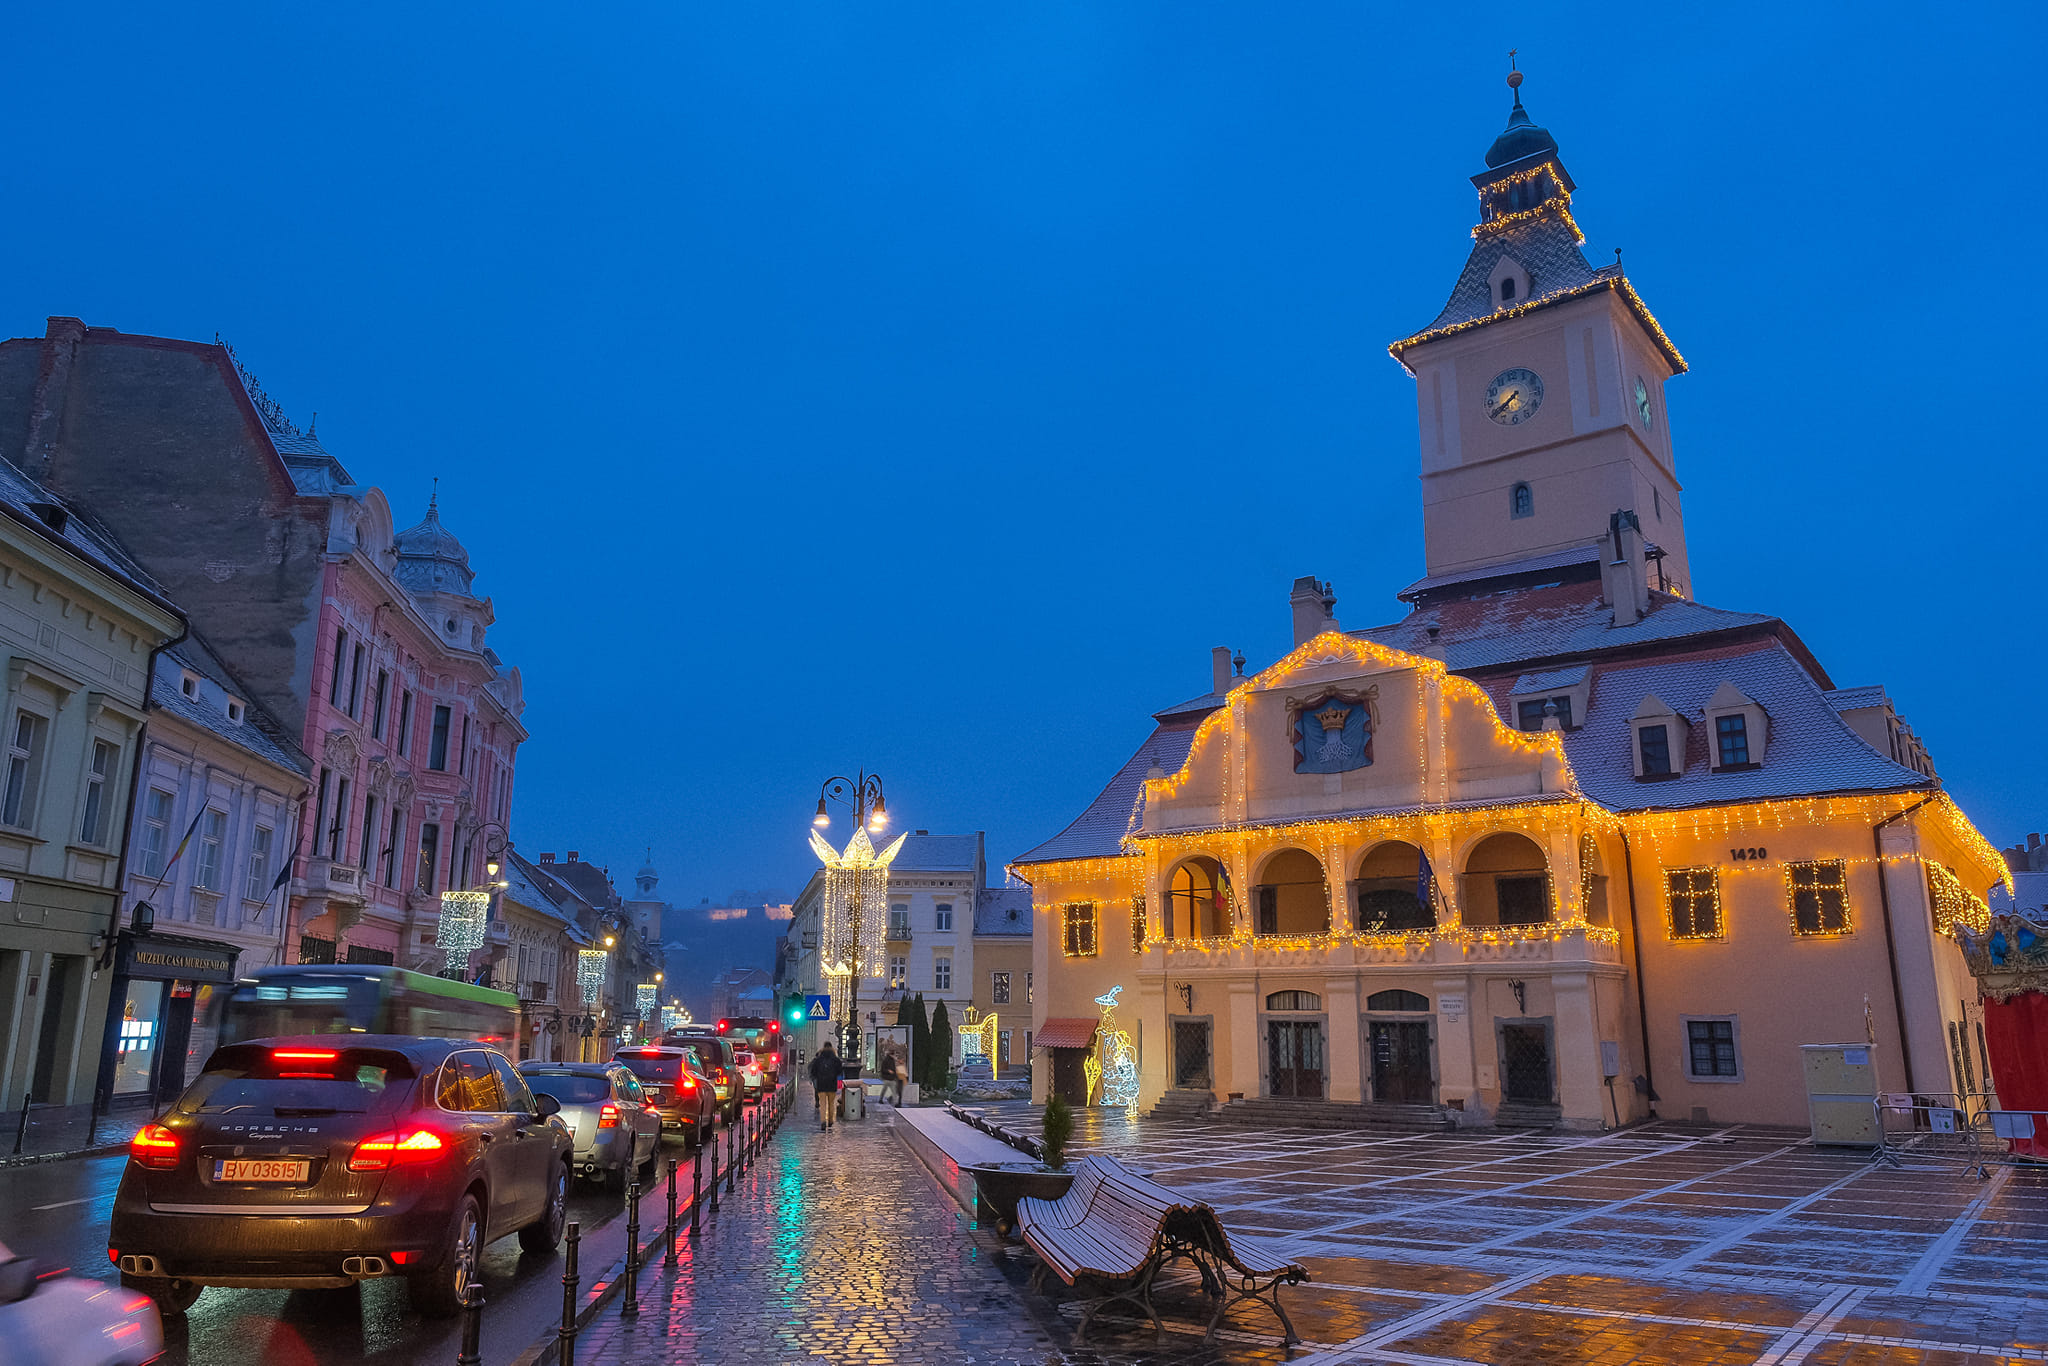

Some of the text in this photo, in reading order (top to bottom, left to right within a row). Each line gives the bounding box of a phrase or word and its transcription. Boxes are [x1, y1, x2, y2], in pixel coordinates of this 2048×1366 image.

[1488, 387, 1498, 397] 10
[1730, 847, 1767, 861] 1420
[136, 951, 165, 966] MUZEUL
[166, 955, 183, 967] CASA
[220, 1125, 319, 1133] PORSCHE
[248, 1132, 283, 1140] Cayenne
[225, 1162, 302, 1178] BV 036151
